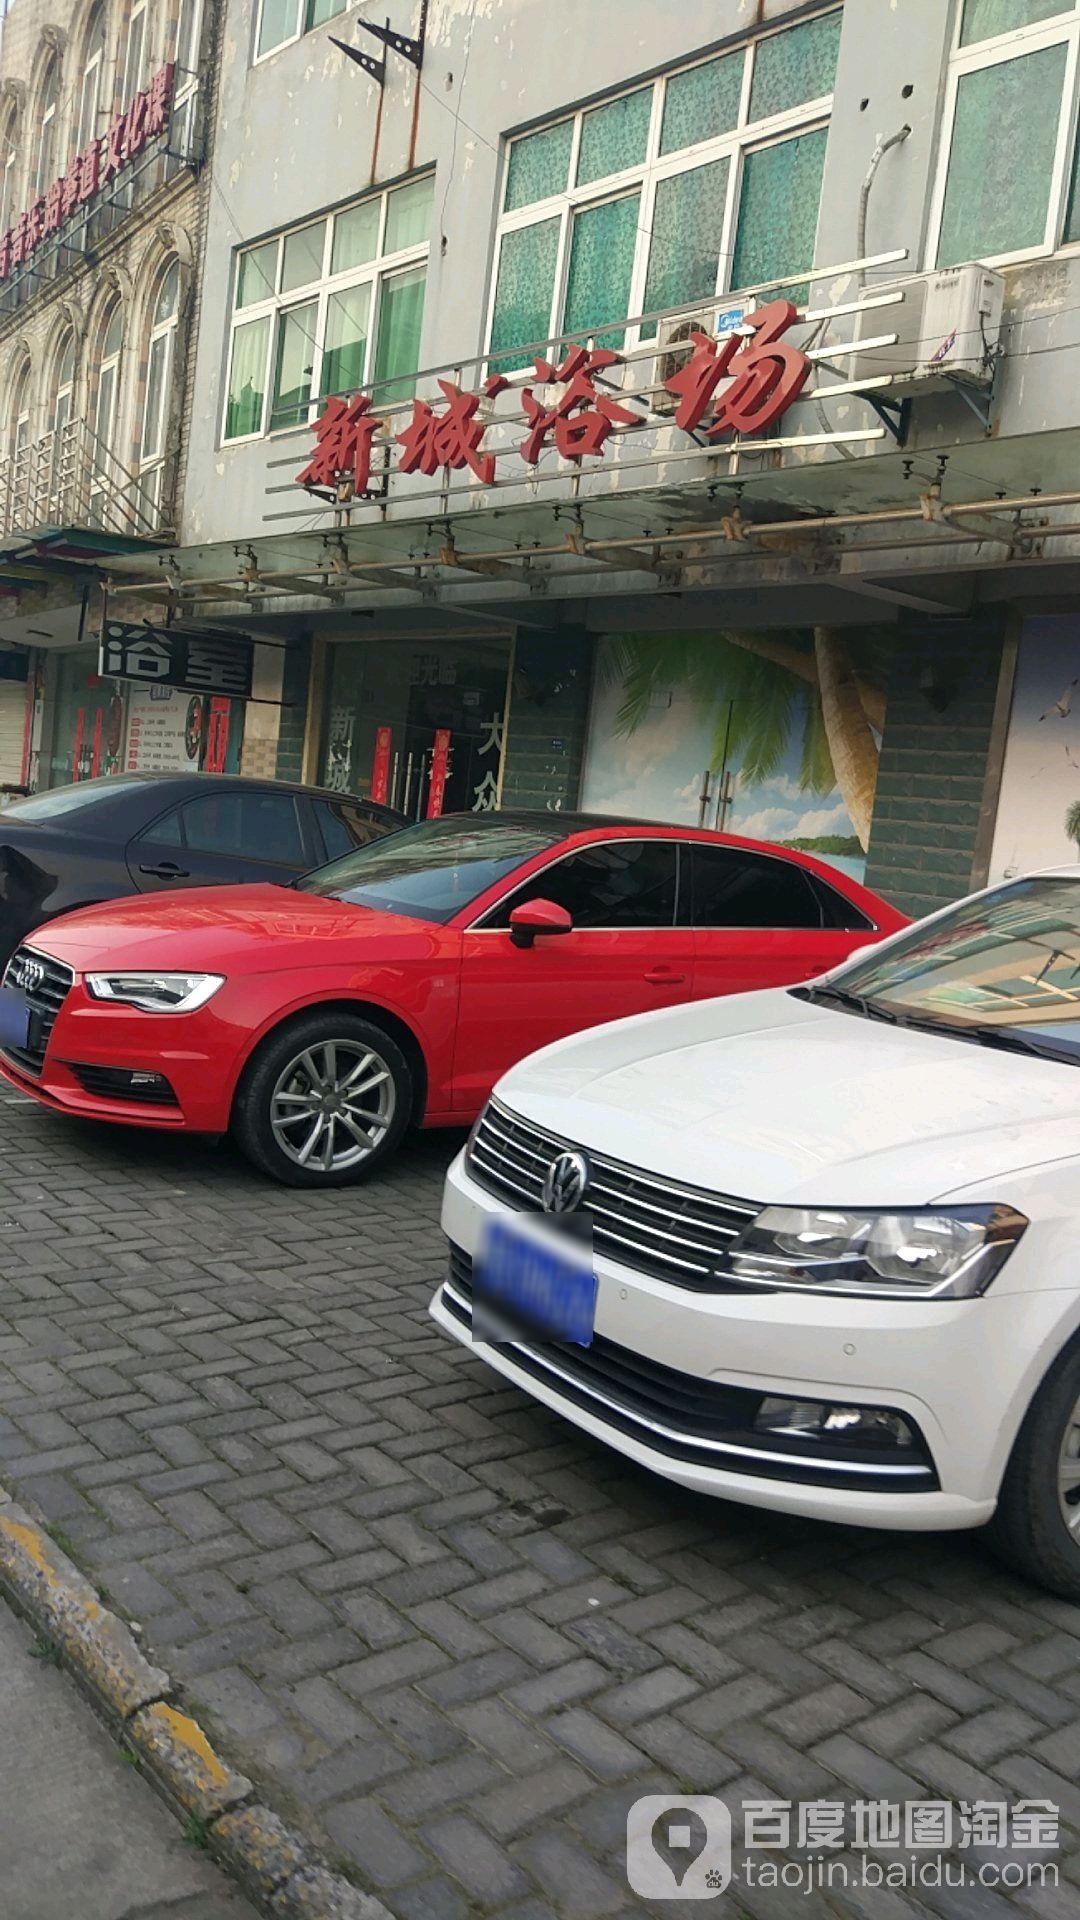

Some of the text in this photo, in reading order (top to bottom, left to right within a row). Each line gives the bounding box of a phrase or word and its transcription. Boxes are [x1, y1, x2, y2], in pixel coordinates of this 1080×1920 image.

[296, 299, 812, 495] 新城浴场
[107, 626, 249, 691] 浴室
